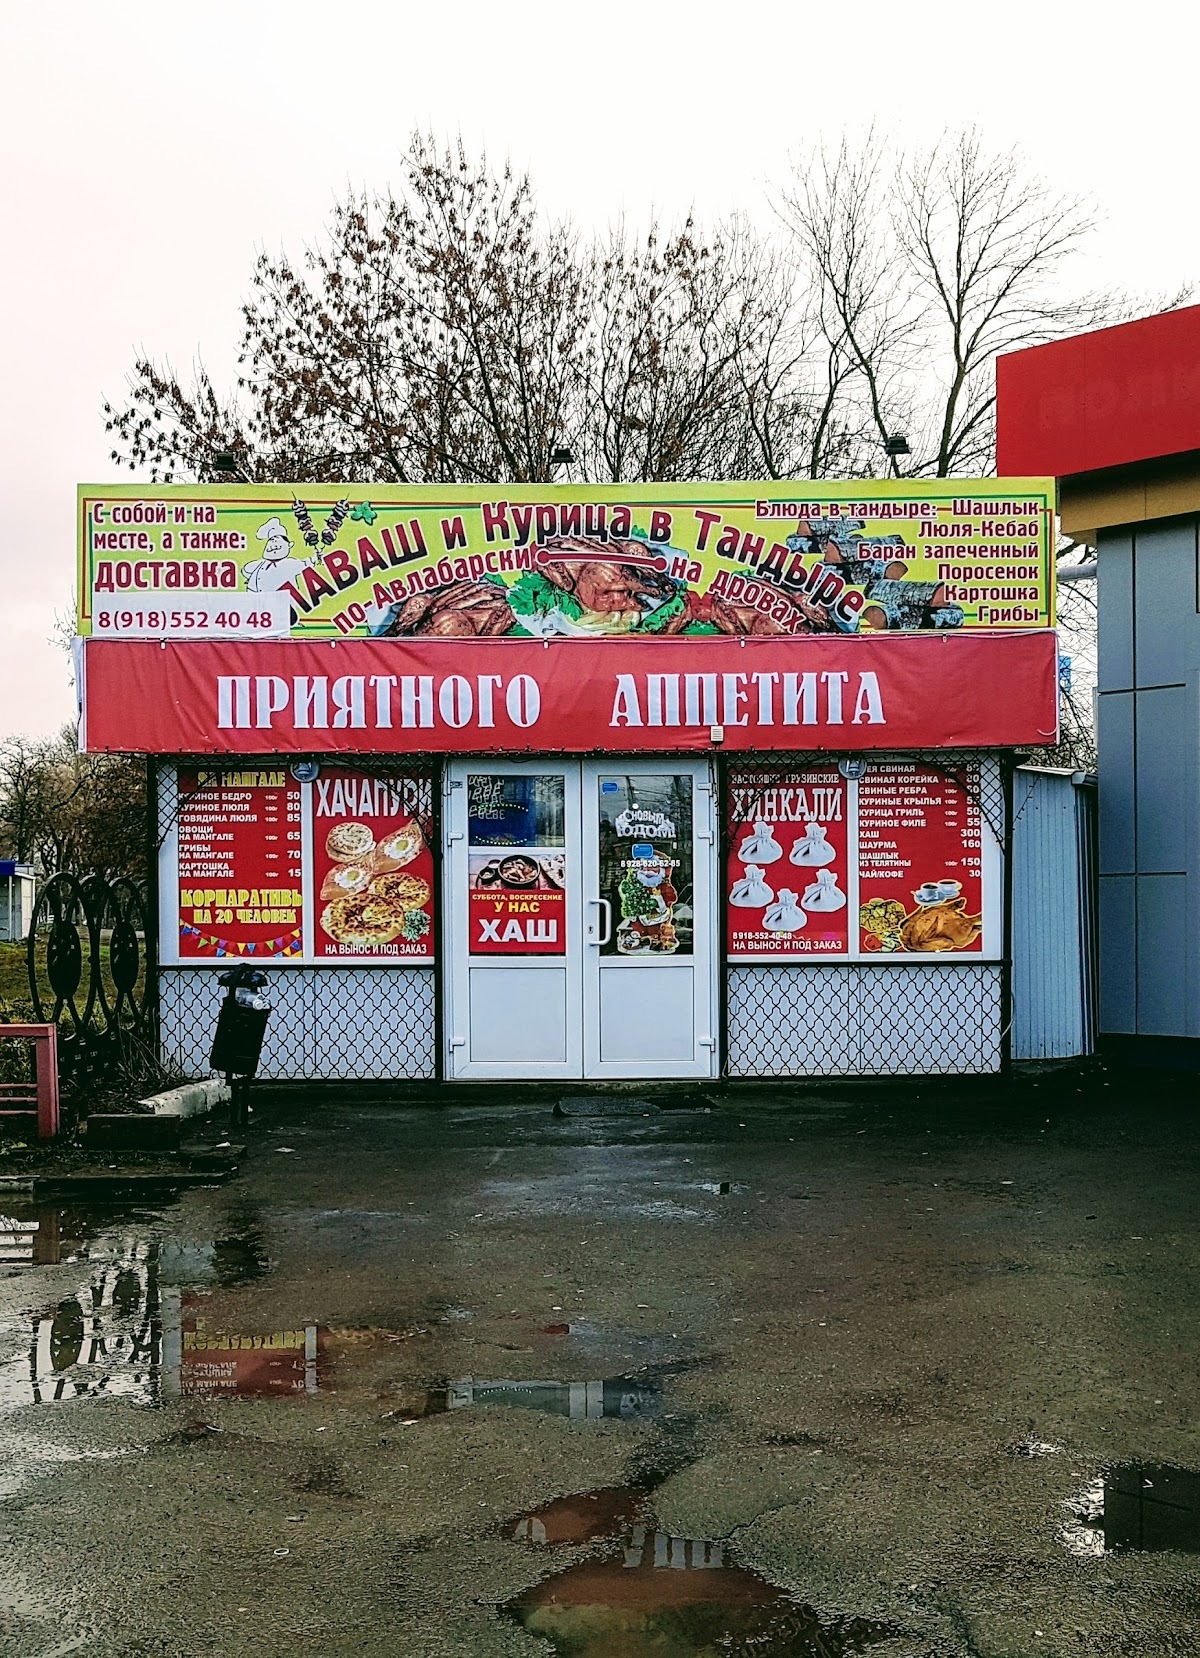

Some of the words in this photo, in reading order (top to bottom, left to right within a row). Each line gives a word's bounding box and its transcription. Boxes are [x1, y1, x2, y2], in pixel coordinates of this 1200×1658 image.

[93, 504, 104, 522] С
[112, 504, 168, 523] собой
[174, 507, 185, 523] и
[193, 506, 215, 523] на
[756, 500, 821, 519] Блюда
[830, 503, 840, 517] в
[850, 502, 938, 519] тандыре:
[952, 499, 1039, 516] Шашлык
[918, 520, 1039, 538] Люля-Кебаб
[94, 533, 154, 553] месте,
[162, 532, 173, 549] а
[181, 532, 246, 550] также:
[858, 544, 916, 560] Баран
[925, 541, 1039, 559] запеченный
[441, 516, 467, 550] и
[481, 501, 632, 546] Курица
[650, 511, 673, 543] в
[694, 510, 865, 622] Тандыре
[938, 563, 1039, 581] Поросенок
[332, 548, 530, 634] по-Авлабарски
[671, 557, 702, 583] на
[708, 570, 806, 634] дровах
[945, 585, 1039, 603] Картошка
[216, 612, 241, 629] 40
[246, 612, 273, 629] 48
[978, 605, 1039, 624] Грибы
[216, 674, 541, 729] ПРИЯТНОГО
[609, 671, 887, 727] АППЕТИТА
[785, 773, 840, 784] ГРУЗИНСКИЕ
[859, 776, 895, 784] СВИНАЯ
[898, 775, 939, 784] КОРЕЙКА
[222, 793, 252, 801] БЕДРО
[287, 792, 300, 800] 50
[316, 778, 432, 817] ХАЧАПУРИ
[287, 803, 300, 811] 80
[731, 788, 843, 822] ХИНКАЛИ
[179, 815, 227, 823] ГОВЯДИНА
[287, 814, 300, 822] 85
[859, 809, 893, 817] КУРИЦА
[966, 807, 980, 815] 50
[967, 818, 980, 826] 55
[179, 826, 213, 834] ОВОЩИ
[287, 832, 300, 840] 65
[960, 829, 980, 837] 300
[962, 840, 980, 848] 160
[961, 858, 980, 866] 150
[288, 869, 301, 877] 15
[859, 870, 904, 878] ЧАЙ/КОФЕ
[969, 870, 980, 878] 30
[494, 901, 504, 913] У
[508, 902, 540, 913] НАС
[193, 909, 212, 924] НА
[215, 909, 233, 924] 20
[236, 909, 297, 924] ЧЕЛОВЕК
[478, 919, 557, 942] ХАШ
[325, 944, 338, 954] НА
[339, 944, 370, 954] ВЫНОС
[373, 944, 378, 954] И
[381, 944, 399, 956] ПОД
[400, 944, 427, 954] ЗАКАЗ
[733, 941, 746, 950] НА
[748, 941, 781, 950] ВЫНОС
[784, 941, 790, 950] И
[792, 941, 812, 951] ПОД
[813, 941, 842, 950] ЗАКАЗ
